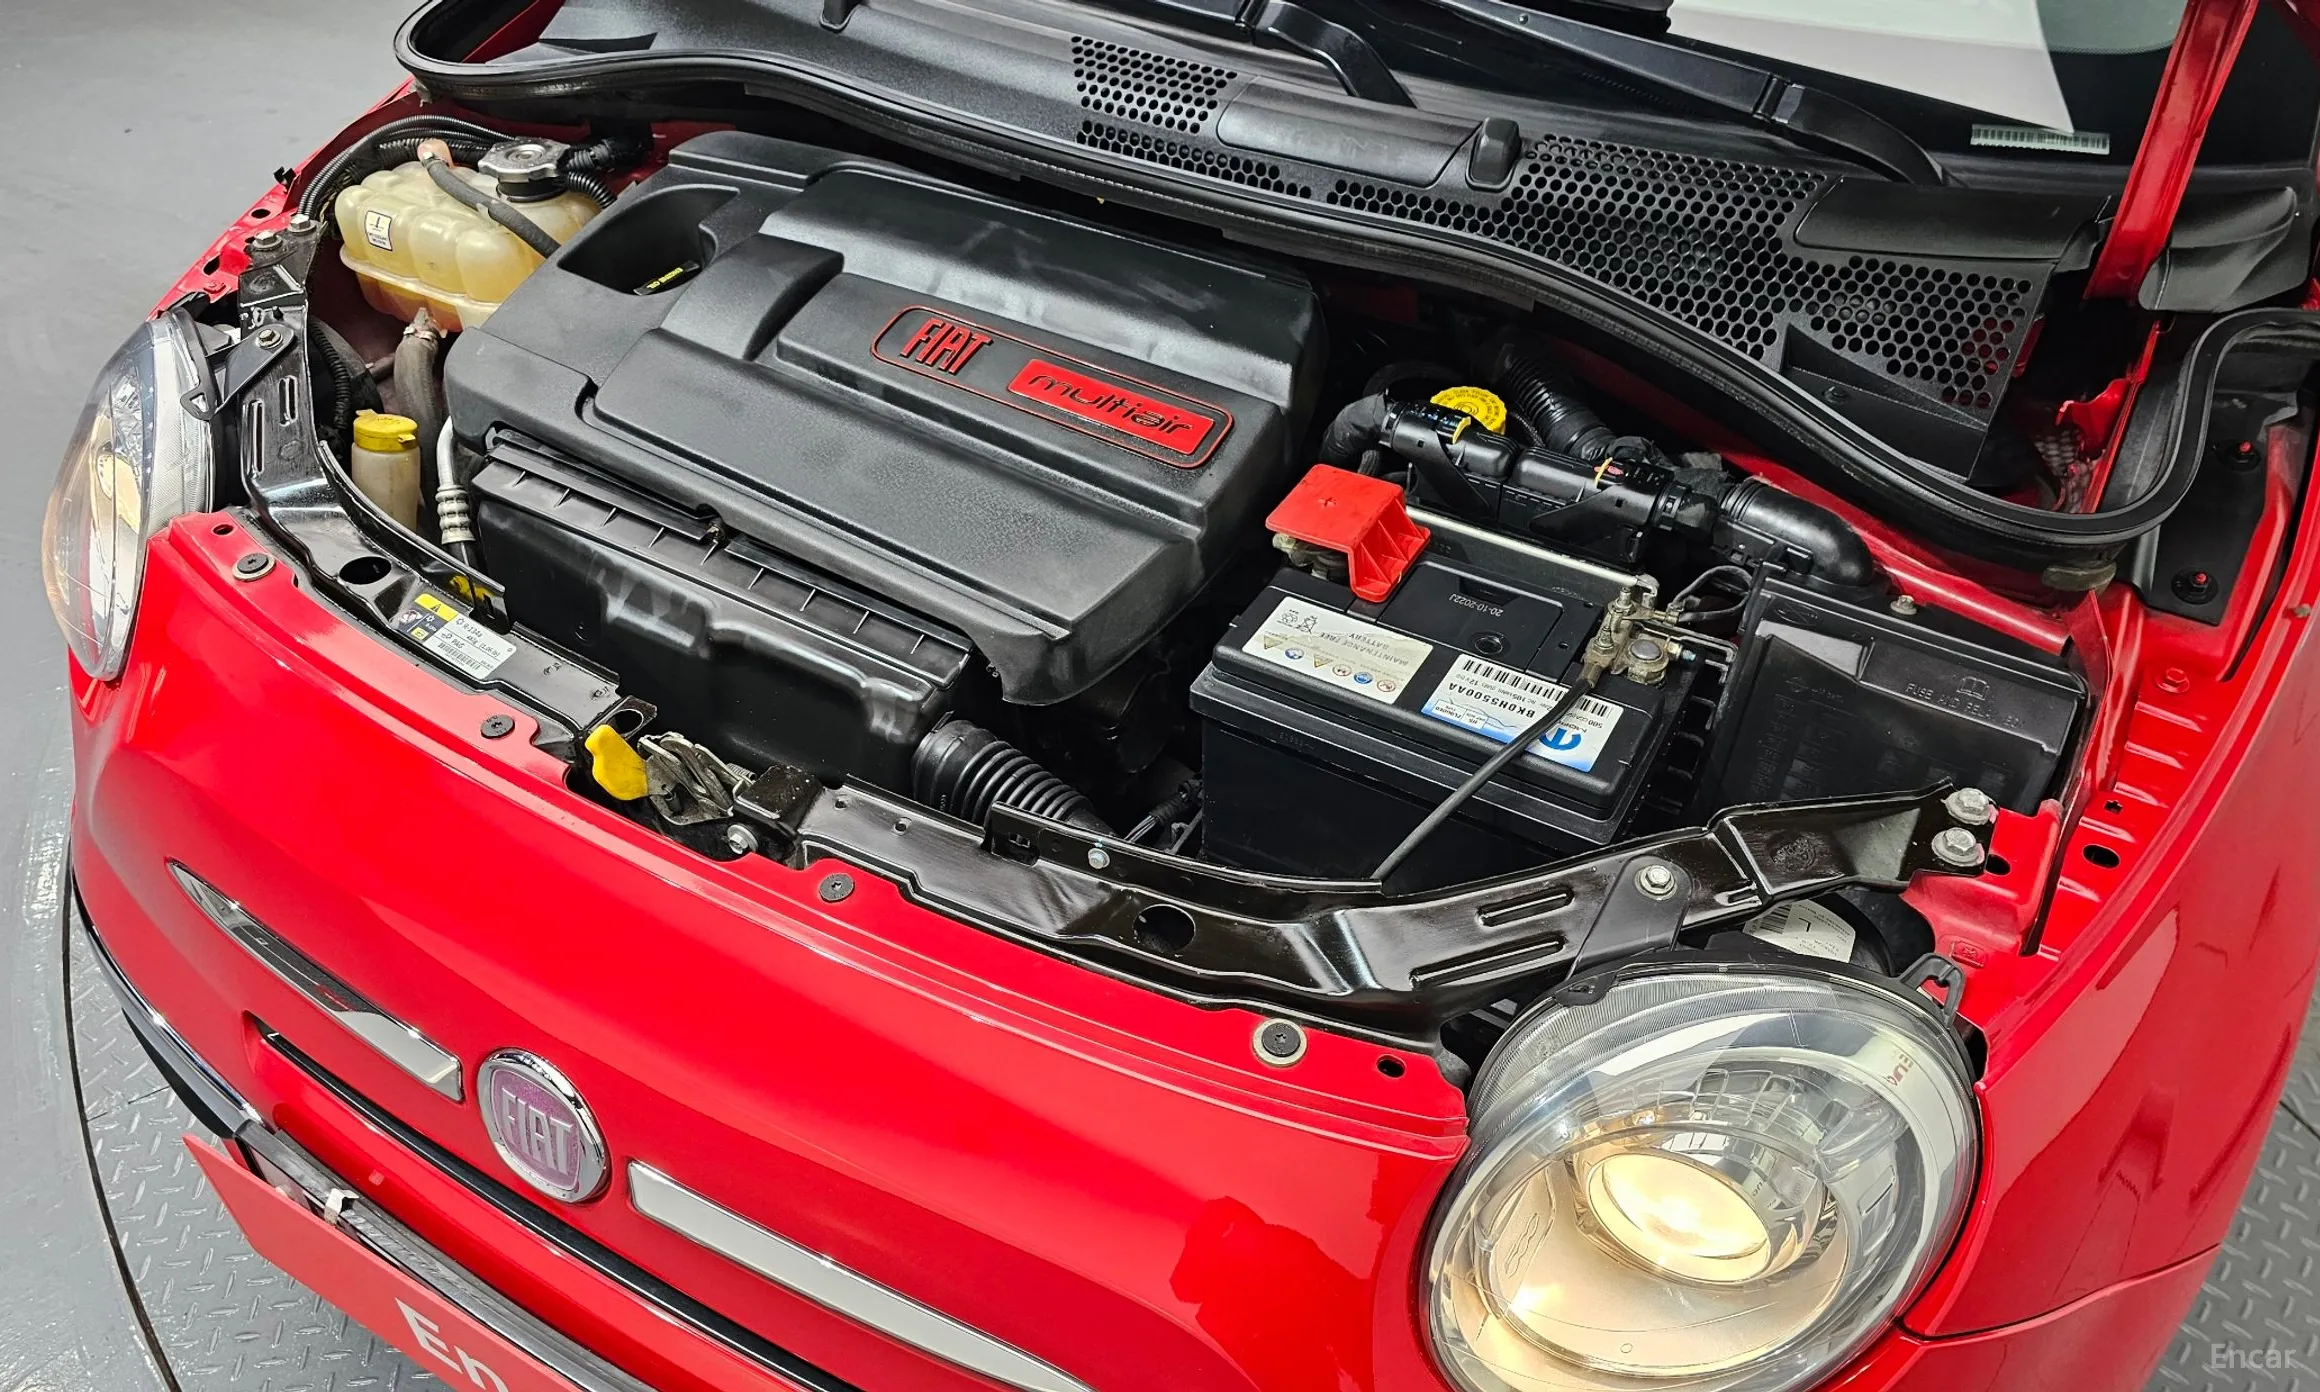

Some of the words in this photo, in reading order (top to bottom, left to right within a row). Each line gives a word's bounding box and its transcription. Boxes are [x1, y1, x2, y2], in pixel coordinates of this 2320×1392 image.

[900, 318, 994, 375] FIAT
[1027, 374, 1192, 434] multiair
[1341, 639, 1409, 667] MAINTENANCE
[1904, 682, 1934, 701] FUSE
[501, 1087, 574, 1176] FIAT
